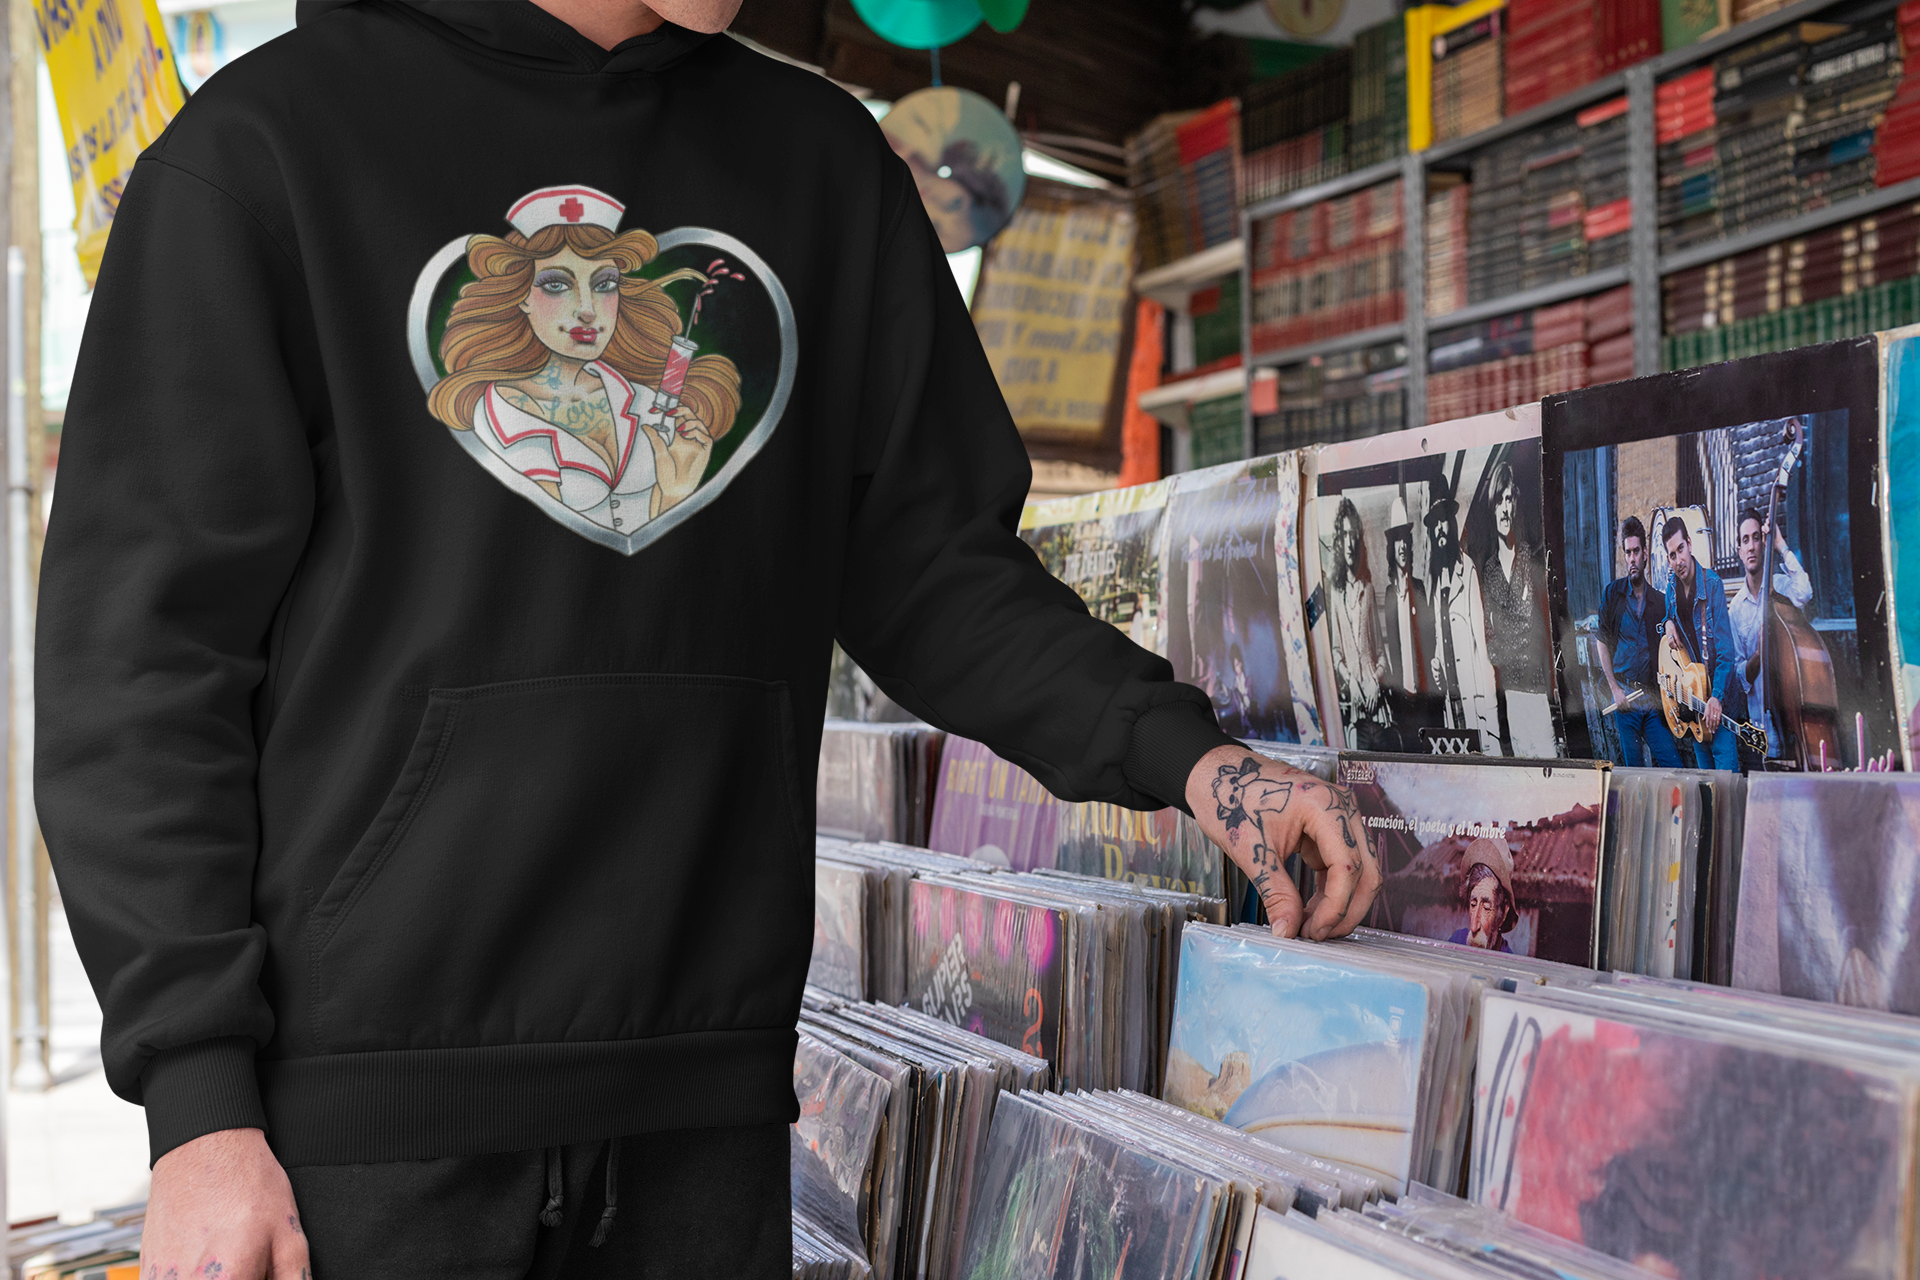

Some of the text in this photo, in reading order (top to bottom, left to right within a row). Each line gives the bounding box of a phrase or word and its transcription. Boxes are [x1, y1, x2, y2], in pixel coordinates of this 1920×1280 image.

[543, 395, 610, 432] Love
[1428, 737, 1470, 754] XXX
[946, 758, 984, 796] RIGHT
[988, 760, 1010, 800] ON
[1347, 769, 1374, 780] ESTEREO
[1368, 814, 1408, 834] canción,
[1409, 817, 1418, 831] el
[1418, 819, 1447, 836] poeta
[1448, 823, 1456, 838] y
[1456, 820, 1466, 835] el
[1466, 821, 1506, 839] hombre
